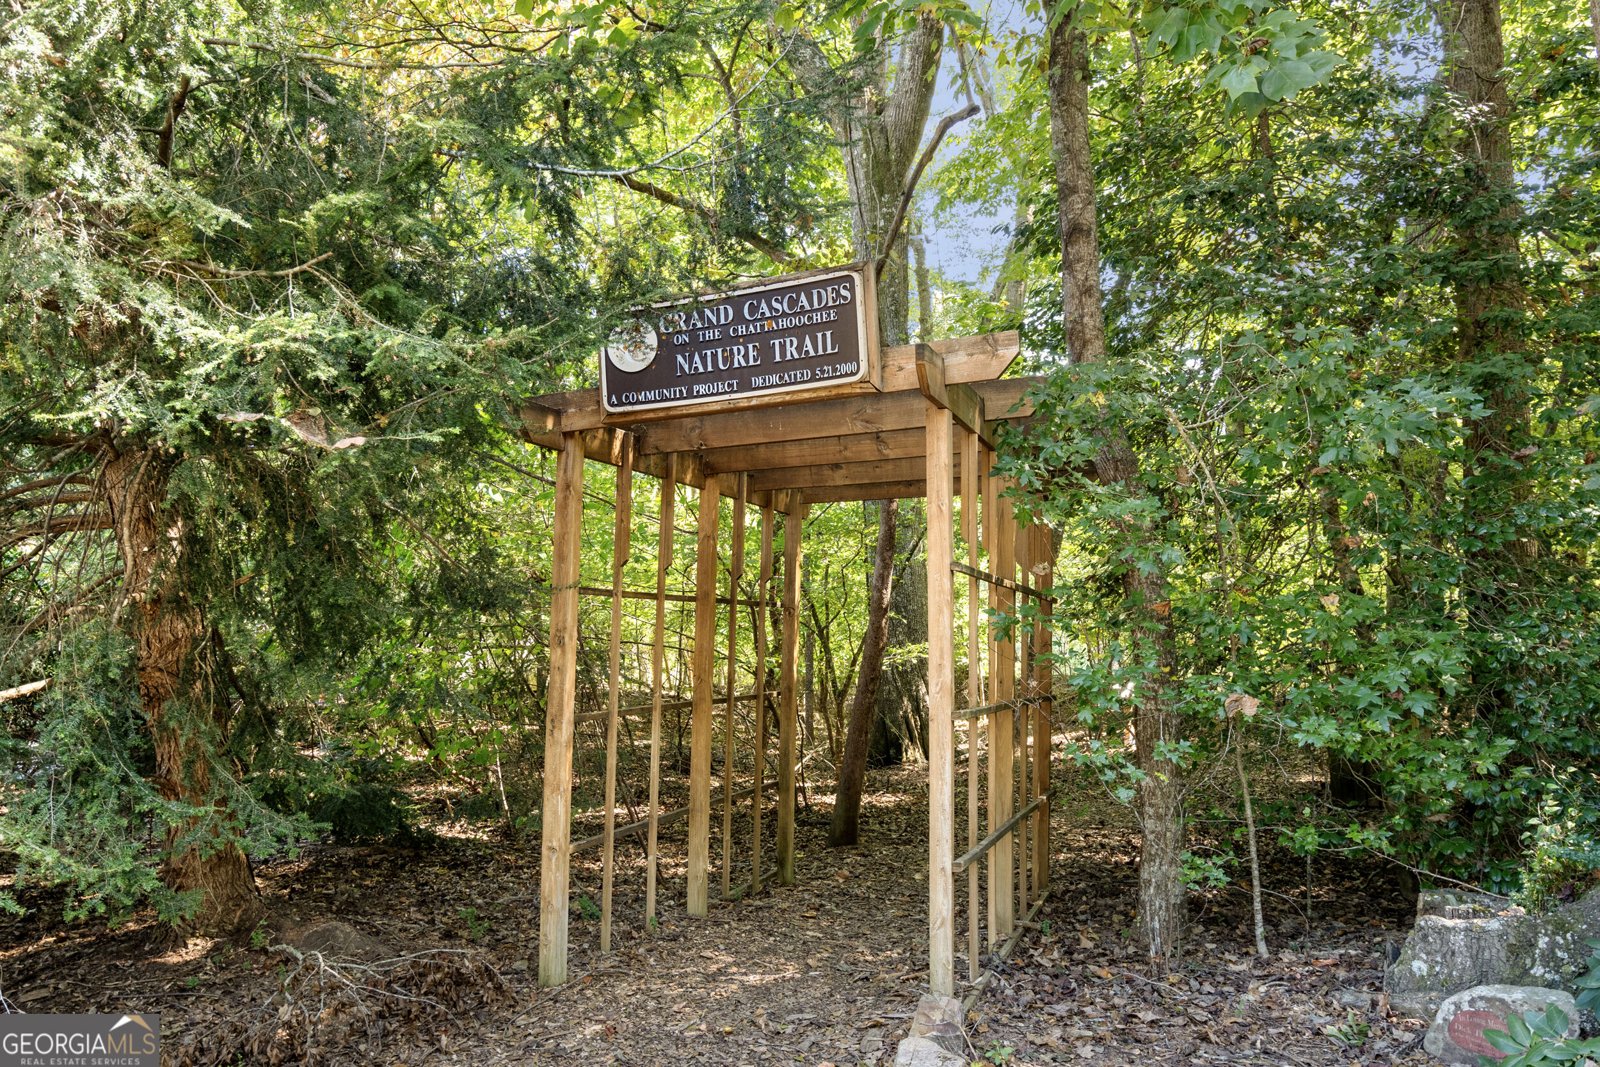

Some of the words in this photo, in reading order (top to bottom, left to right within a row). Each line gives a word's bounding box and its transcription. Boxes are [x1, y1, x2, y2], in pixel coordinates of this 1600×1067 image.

[659, 305, 734, 333] GRAND
[743, 282, 851, 321] CASCADES
[673, 333, 690, 345] ON
[697, 328, 722, 342] THE
[729, 309, 838, 337] CHATTAHOOCHEE
[675, 342, 761, 376] NATURE
[770, 330, 839, 363] TRAIL
[610, 394, 618, 405] A
[622, 386, 688, 403] COMMUNITY
[693, 379, 739, 396] PROJECT
[751, 369, 811, 388] DEDICATED
[815, 361, 858, 379] 5.21.2000
